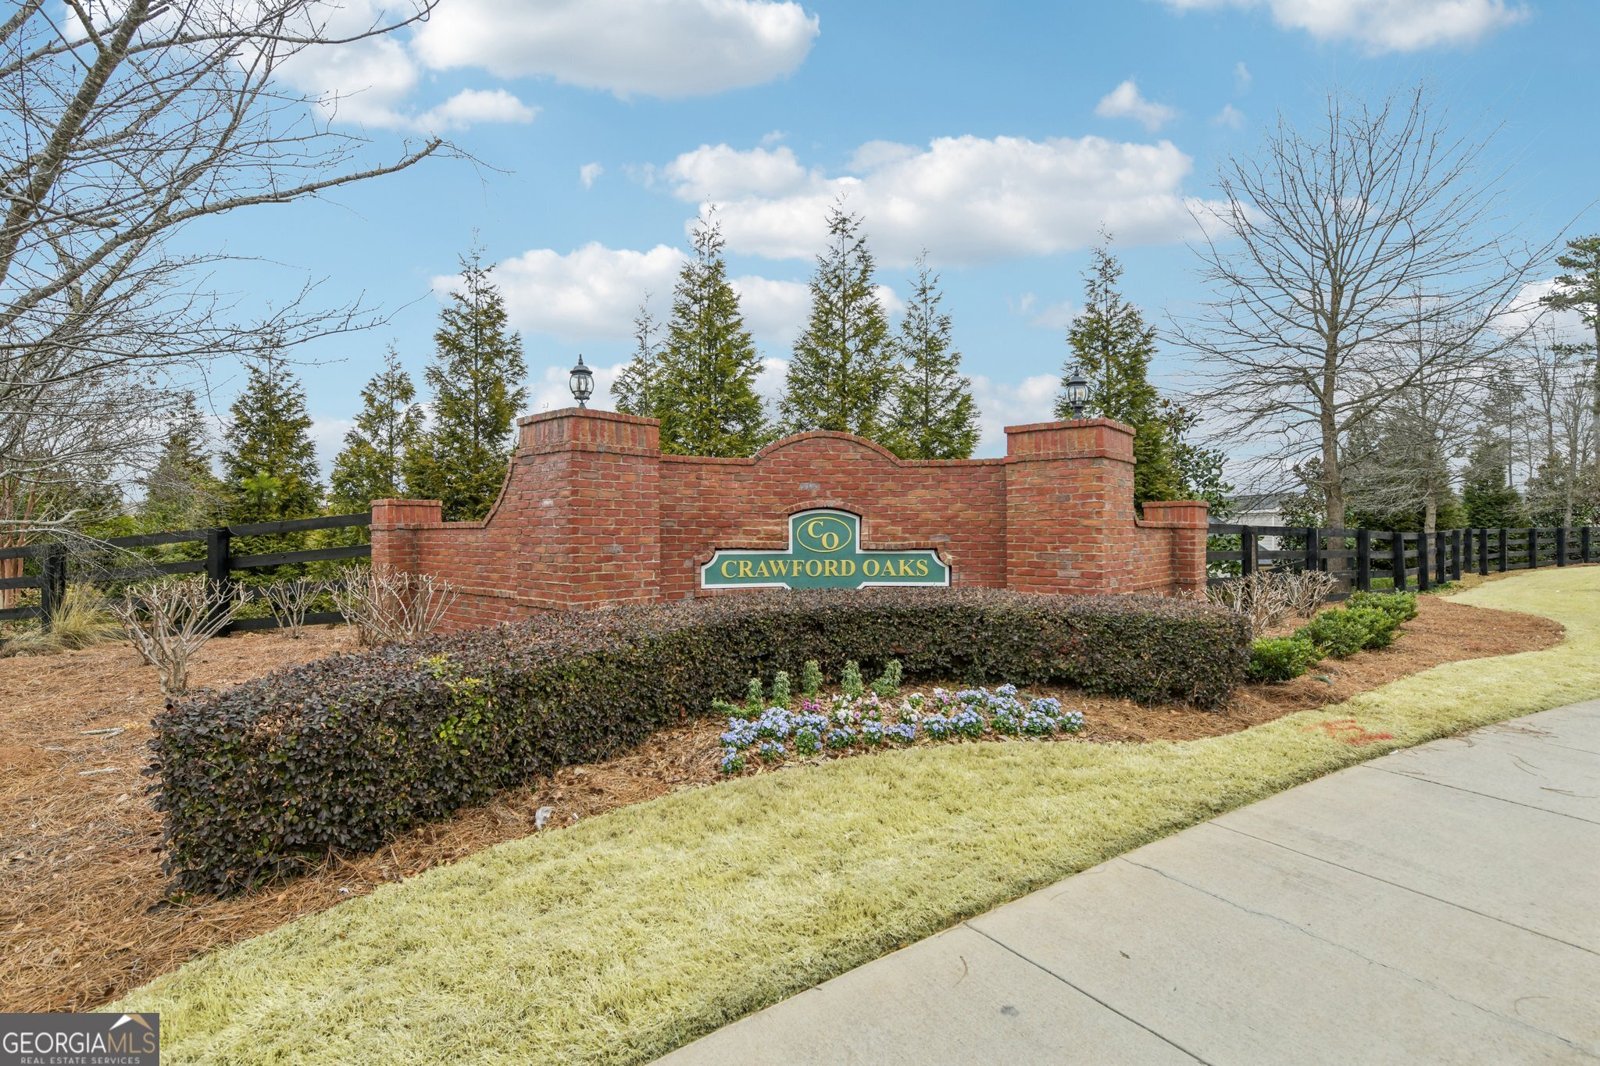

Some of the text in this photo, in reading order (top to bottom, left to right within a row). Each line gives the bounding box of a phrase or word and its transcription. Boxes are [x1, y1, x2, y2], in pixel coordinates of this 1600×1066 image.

[807, 520, 839, 550] CO
[721, 559, 929, 578] CRAWFORD OAKS
